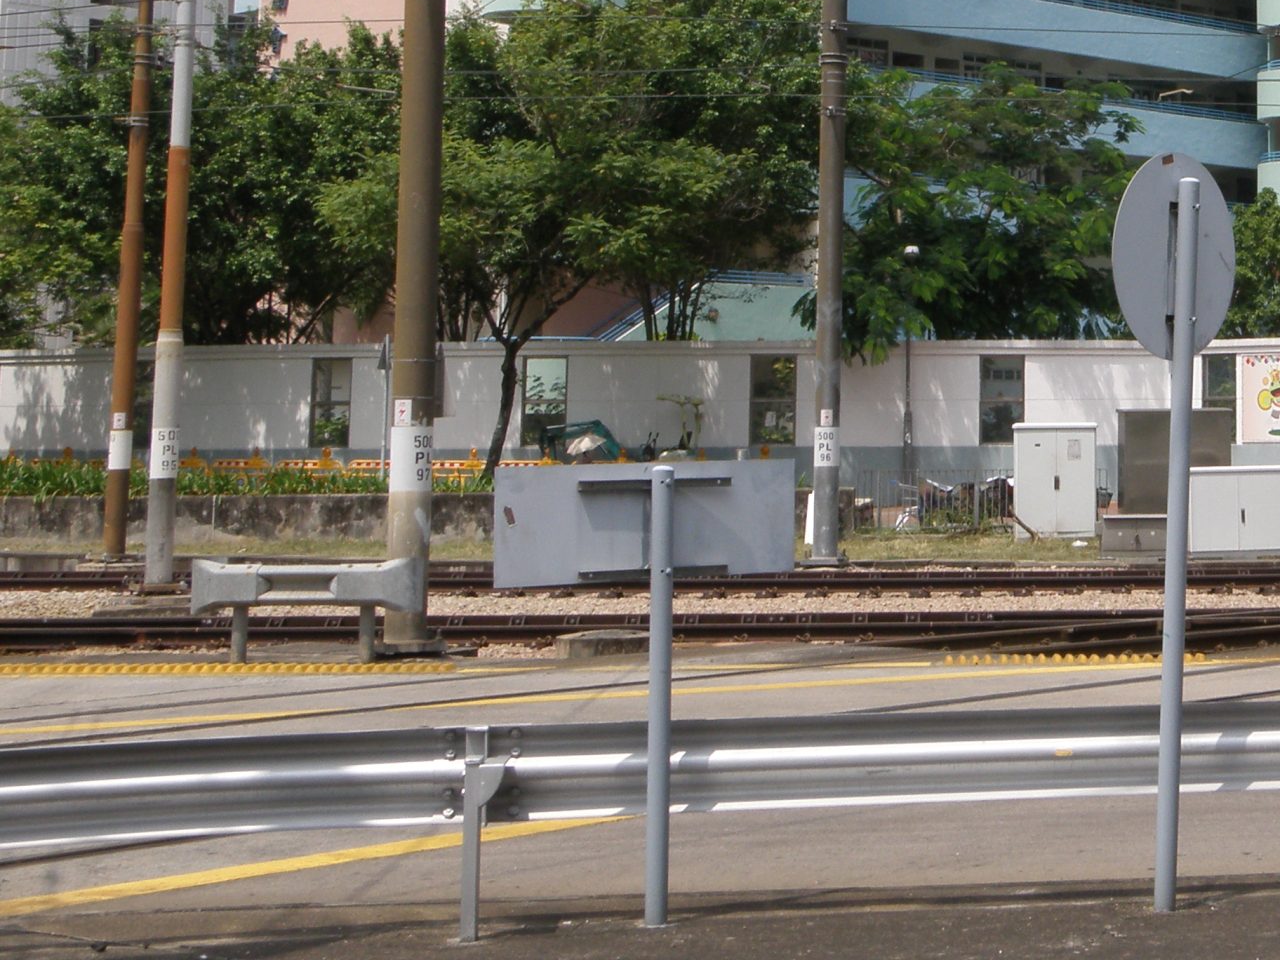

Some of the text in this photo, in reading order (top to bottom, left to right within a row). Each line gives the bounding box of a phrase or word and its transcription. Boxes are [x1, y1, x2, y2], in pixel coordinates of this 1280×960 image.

[818, 431, 834, 441] 500
[162, 445, 177, 455] PL
[818, 442, 832, 452] PL
[415, 451, 432, 465] PL
[820, 453, 832, 462] 96
[416, 468, 431, 481] 97
